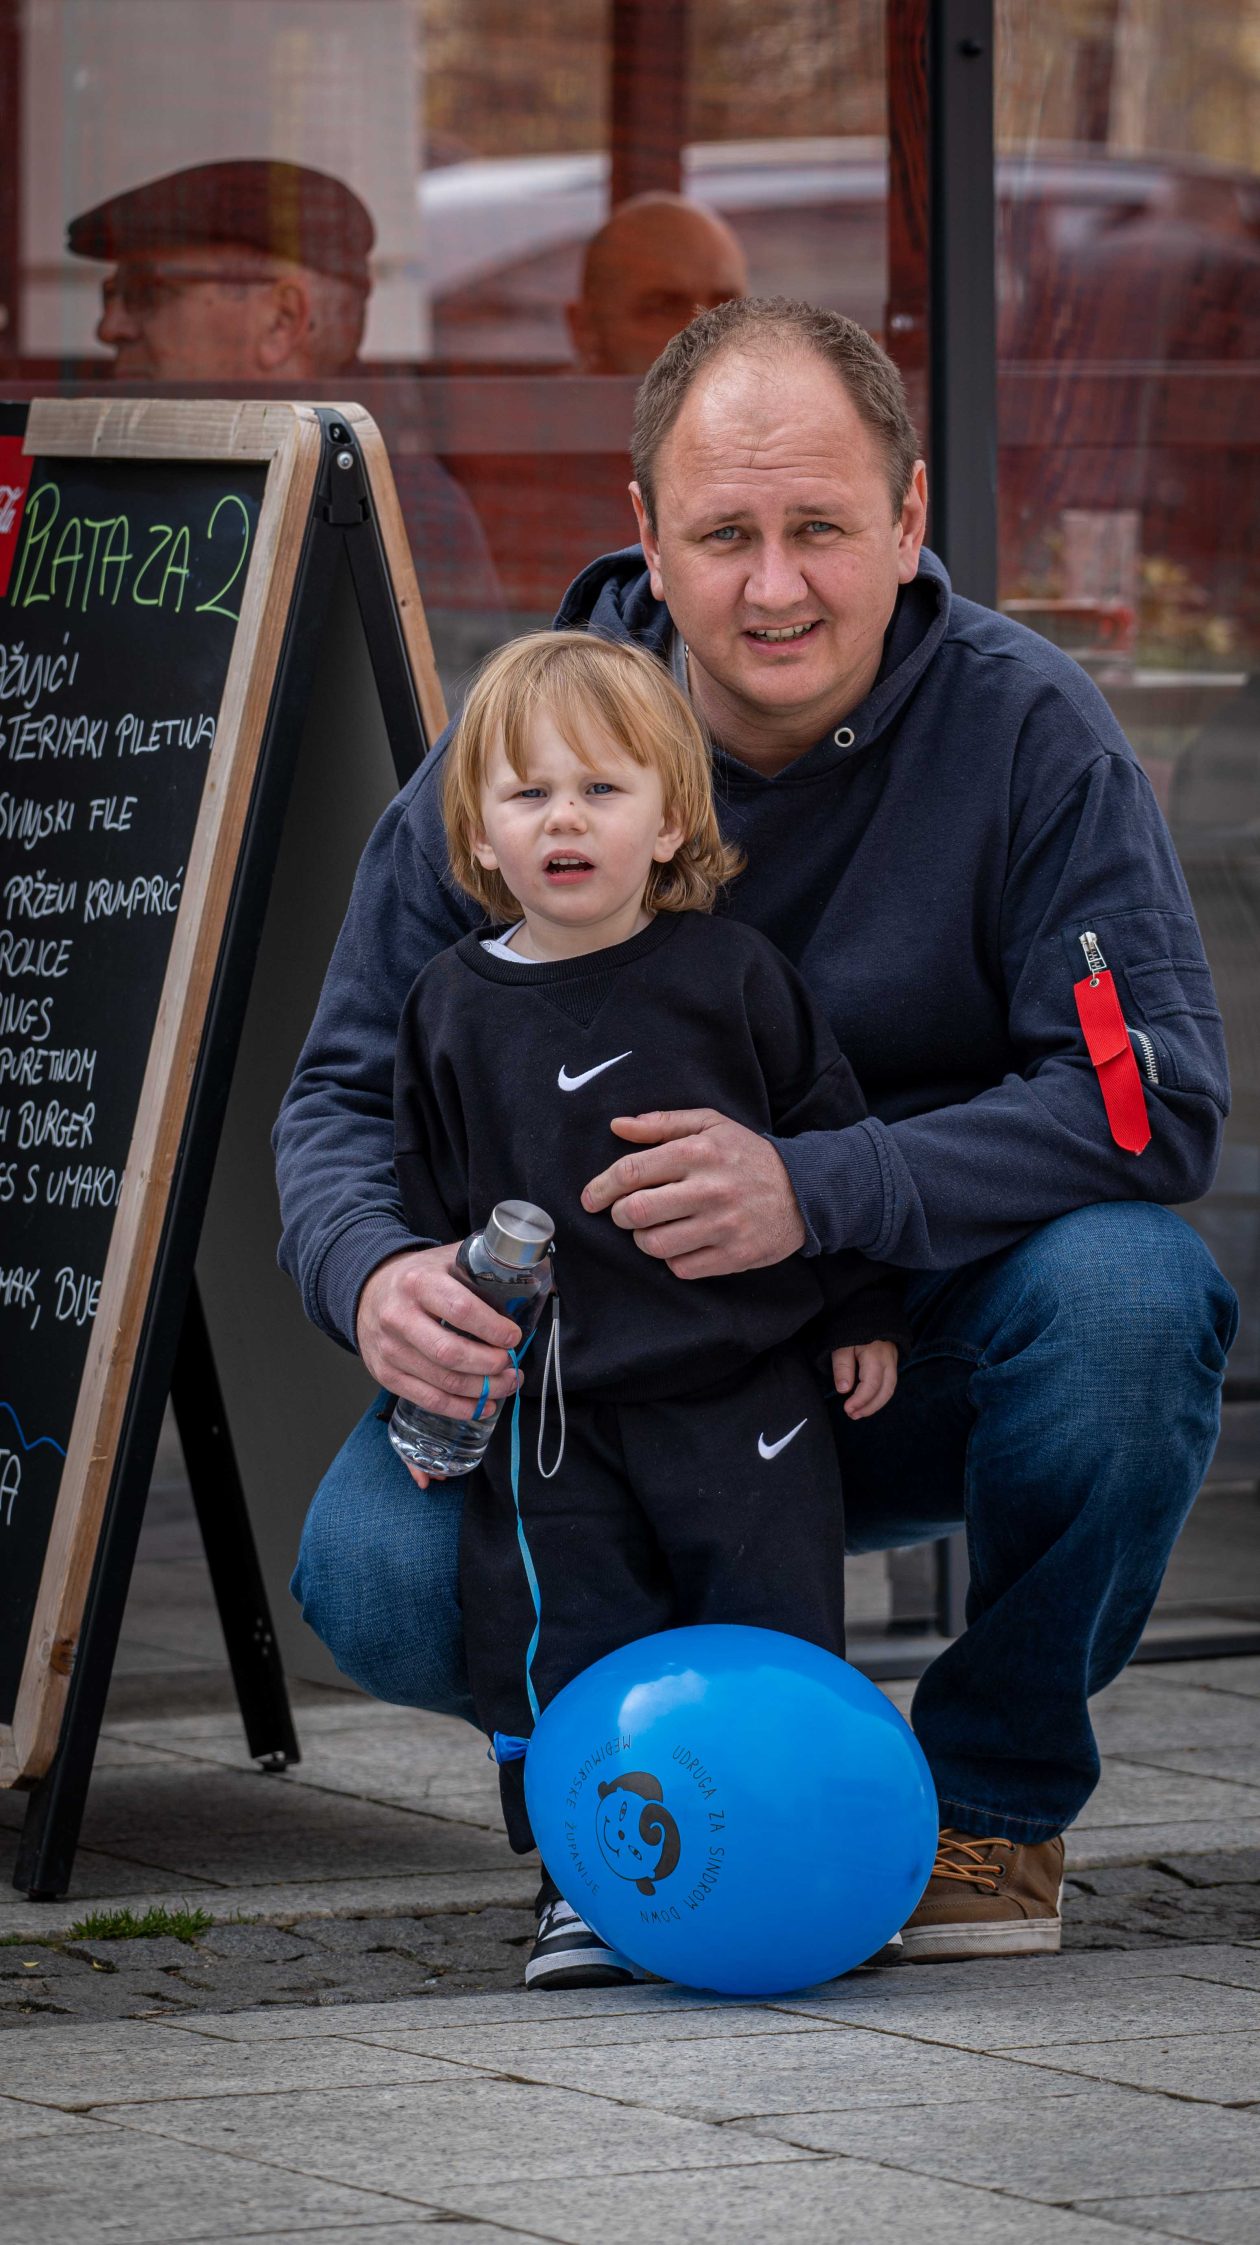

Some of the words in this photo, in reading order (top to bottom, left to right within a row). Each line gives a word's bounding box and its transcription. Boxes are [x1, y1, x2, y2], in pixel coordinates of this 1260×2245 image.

[11, 482, 133, 613] PLATA
[132, 524, 191, 613] ZA
[195, 494, 250, 621] 2
[7, 712, 109, 762] TERIYAKI
[115, 713, 216, 759] PILETINA
[89, 795, 139, 832] FILE
[3, 868, 78, 921] PRŽENI
[0, 991, 55, 1043] INGS
[18, 1099, 96, 1151] BURGER
[46, 1163, 125, 1210] UMAKO
[671, 1745, 717, 1800] UDRUGA
[708, 1809, 725, 1833] ZA
[683, 1847, 725, 1911] SINDROM
[640, 1906, 681, 1923] DOWN
